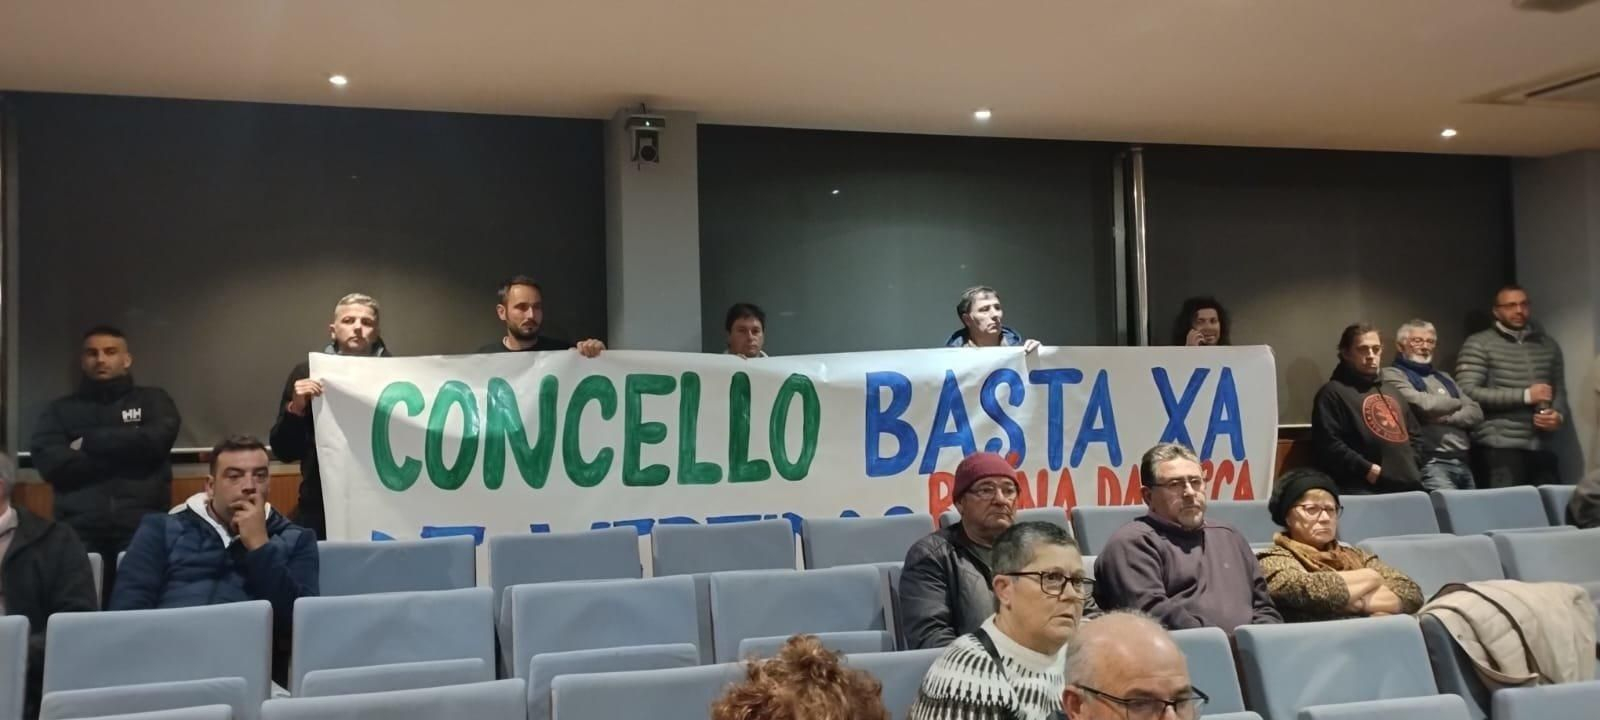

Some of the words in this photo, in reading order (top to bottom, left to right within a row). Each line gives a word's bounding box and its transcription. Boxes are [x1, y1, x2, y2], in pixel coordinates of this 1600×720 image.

[371, 371, 821, 492] CONCELLO
[865, 368, 1123, 477] BASTA
[1151, 367, 1246, 461] XA
